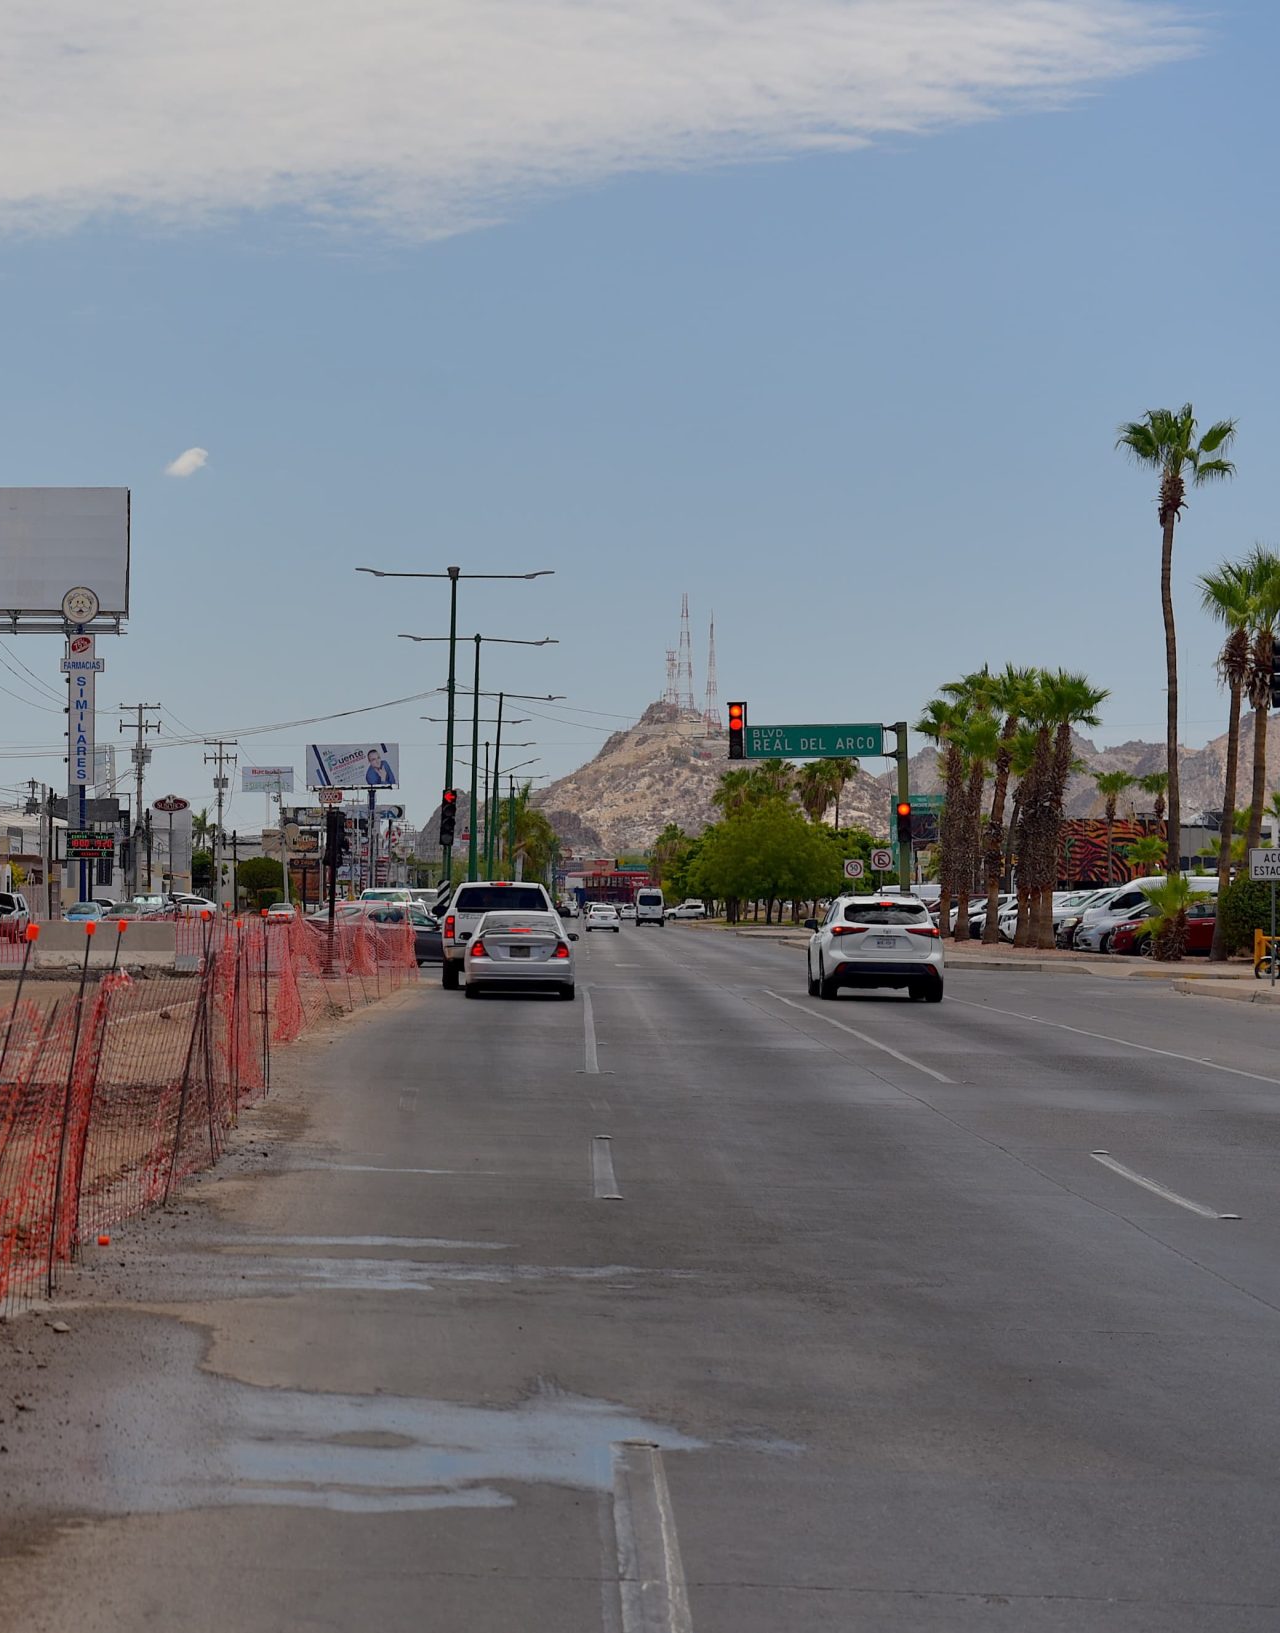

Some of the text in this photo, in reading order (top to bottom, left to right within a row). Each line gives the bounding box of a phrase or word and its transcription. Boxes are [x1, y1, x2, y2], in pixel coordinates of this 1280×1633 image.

[63, 661, 101, 670] FARMACIAS
[75, 676, 88, 780] SIMILARES
[753, 729, 786, 738] BLVD.
[753, 737, 875, 751] REAL DEL ARCO
[850, 864, 858, 872] 50
